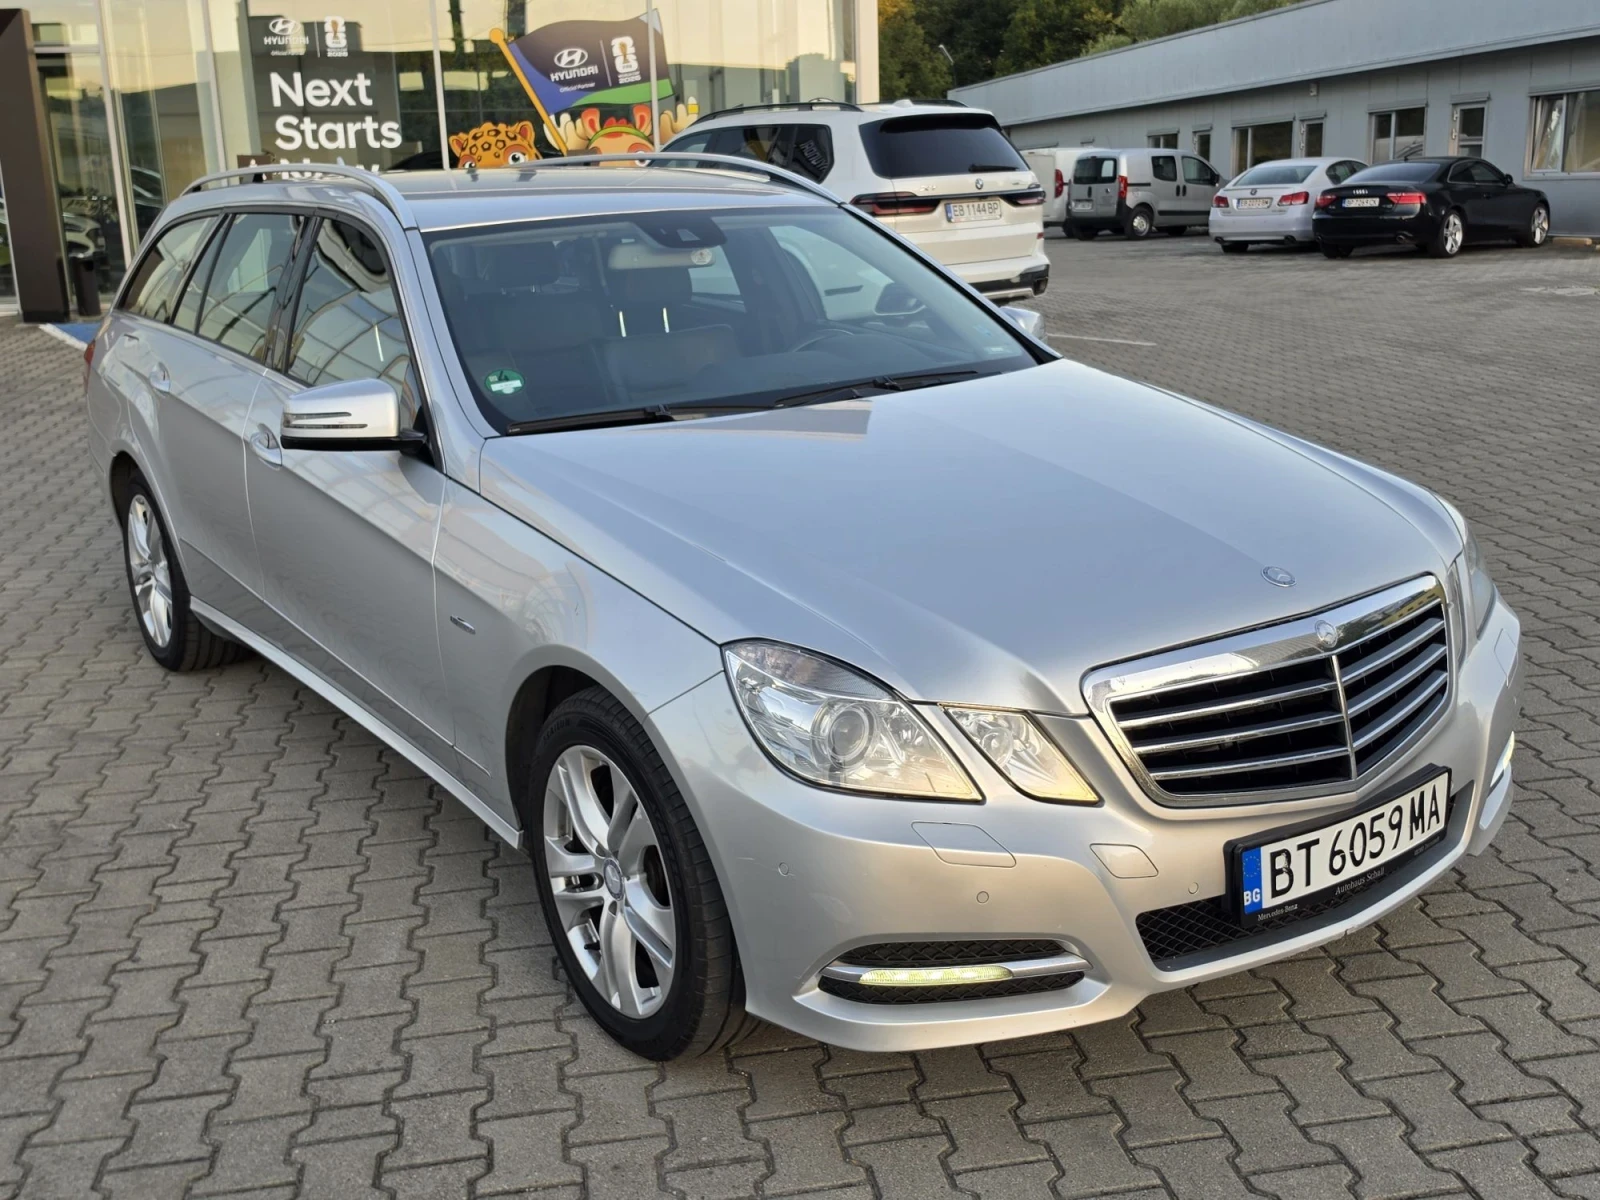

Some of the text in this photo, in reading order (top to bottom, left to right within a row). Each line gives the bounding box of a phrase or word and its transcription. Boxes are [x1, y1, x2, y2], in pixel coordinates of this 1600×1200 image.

[263, 35, 309, 45] HYUNDAI
[550, 65, 598, 81] HYUNDAI
[618, 74, 641, 84] 2026
[269, 71, 373, 107] Next
[559, 81, 596, 93] Official Partner
[274, 114, 402, 150] Starts
[953, 202, 999, 216] EB 1144 BP
[1270, 784, 1441, 899] BT 6059 MA
[1335, 877, 1365, 896] Autohaus
[1243, 887, 1261, 906] BG
